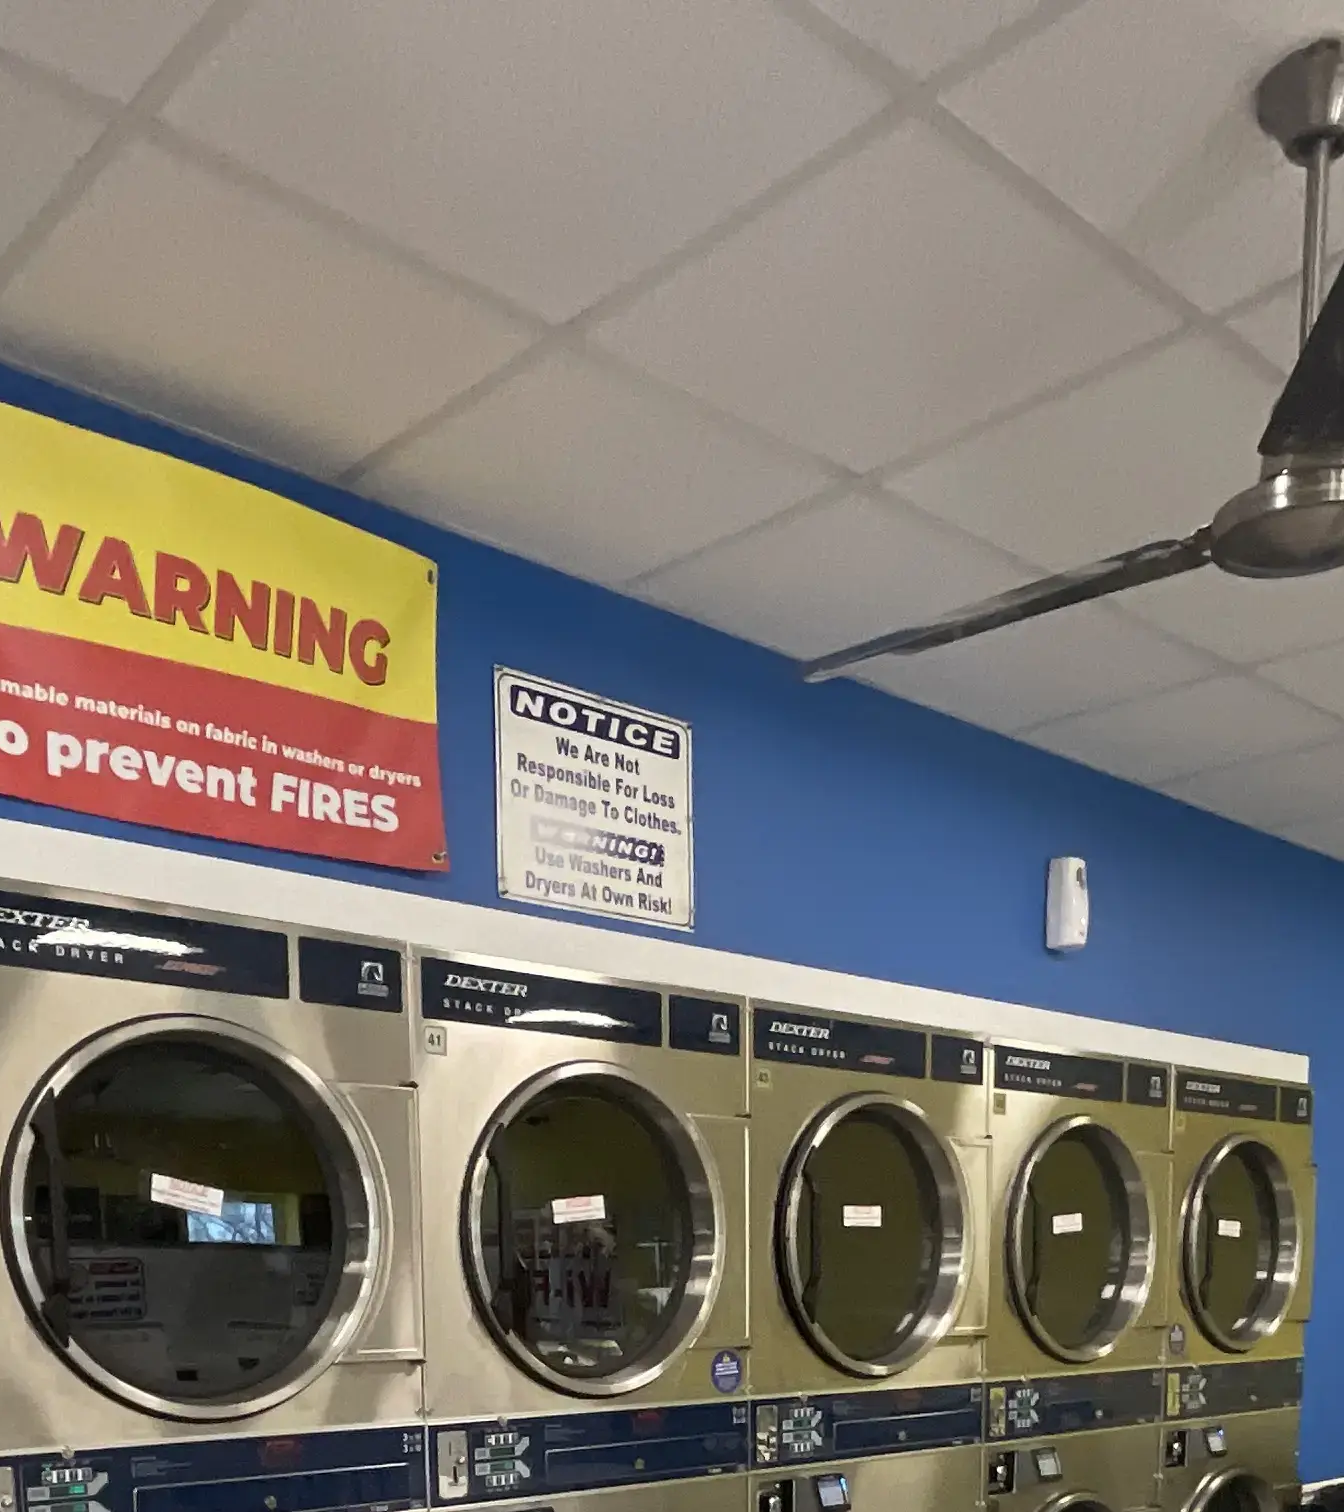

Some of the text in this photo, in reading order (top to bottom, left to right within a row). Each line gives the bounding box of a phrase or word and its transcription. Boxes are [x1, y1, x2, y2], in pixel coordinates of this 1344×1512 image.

[74, 691, 172, 730] materials
[175, 718, 201, 736] on
[204, 722, 257, 750] fabric
[261, 734, 278, 756] in
[282, 745, 345, 774] washers
[347, 761, 365, 777] or
[369, 760, 422, 789] dryers
[515, 690, 674, 754] NOTICE
[556, 736, 640, 776] We Are Not
[46, 730, 258, 808] prevent
[271, 771, 400, 833] FIRES
[516, 752, 675, 809] Responsible For Loss
[510, 778, 682, 836] Or Damage To Clothes.
[535, 846, 663, 889] Use Washers And
[525, 870, 672, 915] Dryers At Own Risk!
[56, 944, 125, 965] DRYER
[443, 998, 494, 1014] STACK
[444, 974, 528, 998] DEXTER
[427, 1033, 442, 1046] 41
[769, 1021, 830, 1039] DEXTER
